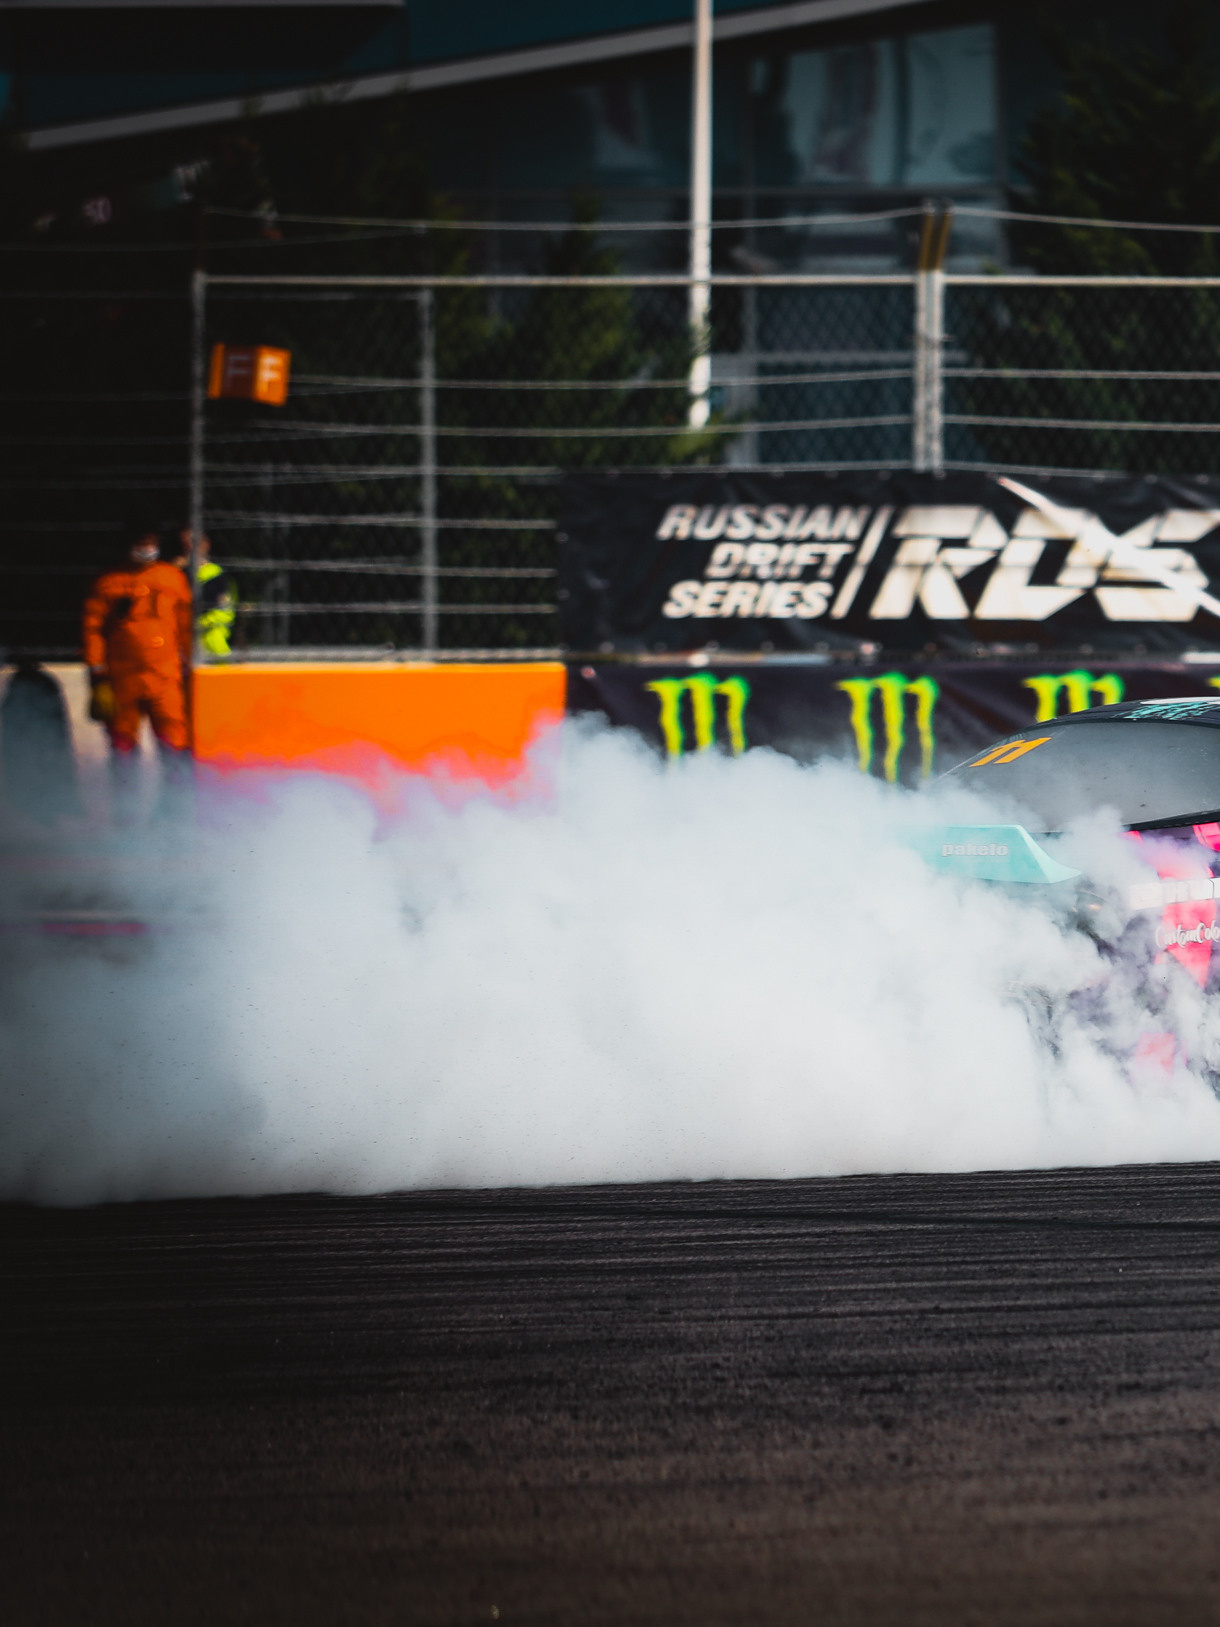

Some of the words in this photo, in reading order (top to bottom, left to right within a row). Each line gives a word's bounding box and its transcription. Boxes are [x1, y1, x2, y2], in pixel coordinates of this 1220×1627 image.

[656, 504, 869, 541] RUSSIAN
[705, 542, 854, 579] DRIFT
[661, 580, 834, 620] SERIES
[969, 737, 1052, 768] 11
[941, 842, 1009, 858] pakelo
